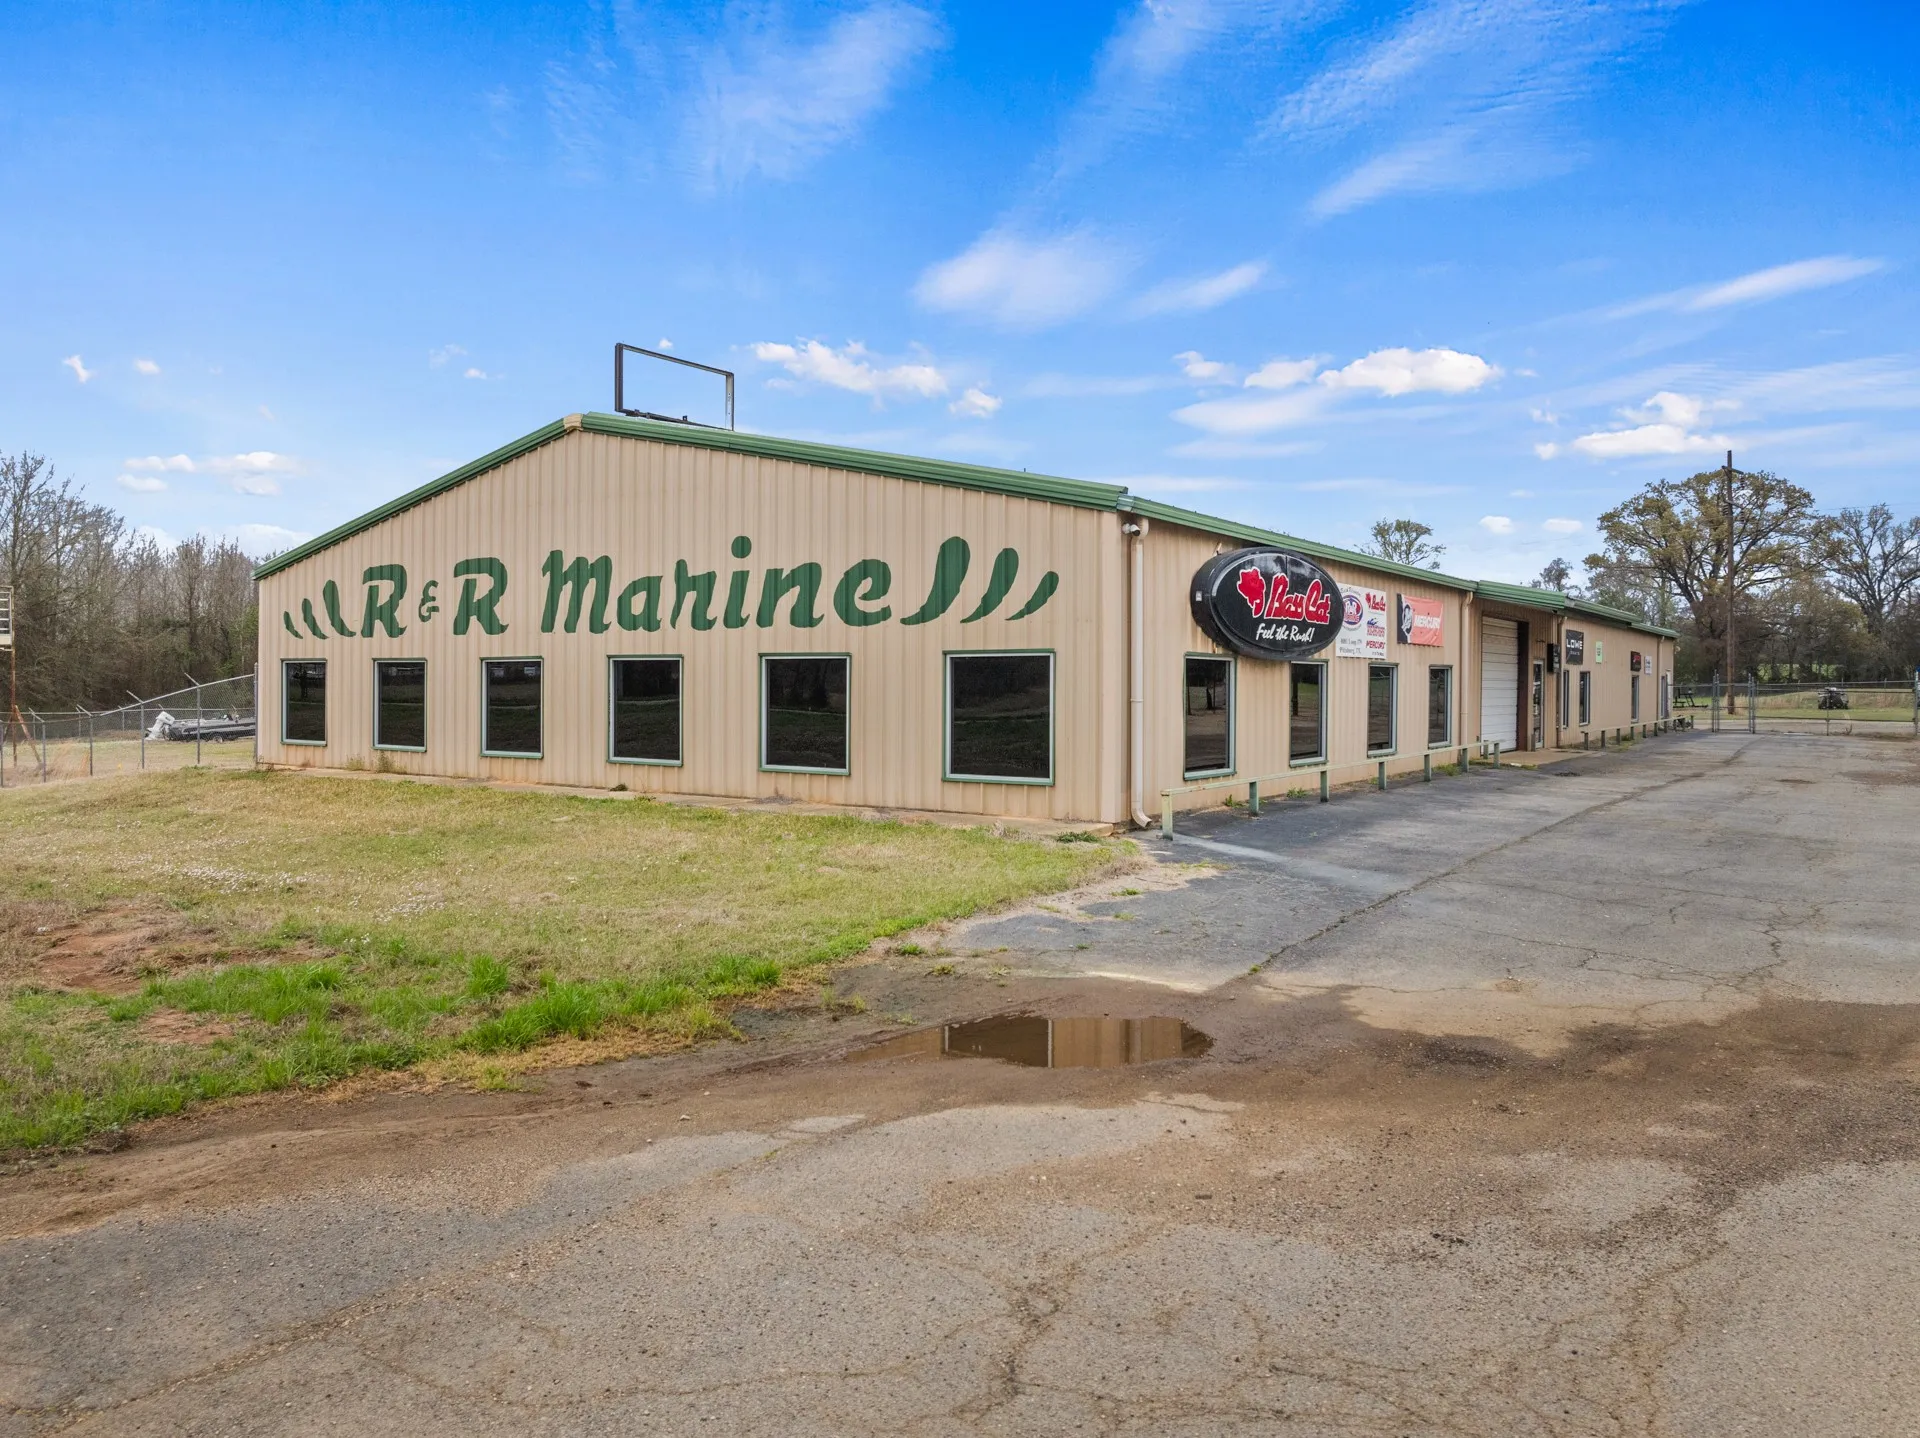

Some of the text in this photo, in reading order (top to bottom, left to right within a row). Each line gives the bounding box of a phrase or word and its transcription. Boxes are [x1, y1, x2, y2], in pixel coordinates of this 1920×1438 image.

[362, 536, 892, 637] R & R Marine
[1414, 614, 1441, 629] MERCURY
[1256, 623, 1315, 642] Feel the Rush!
